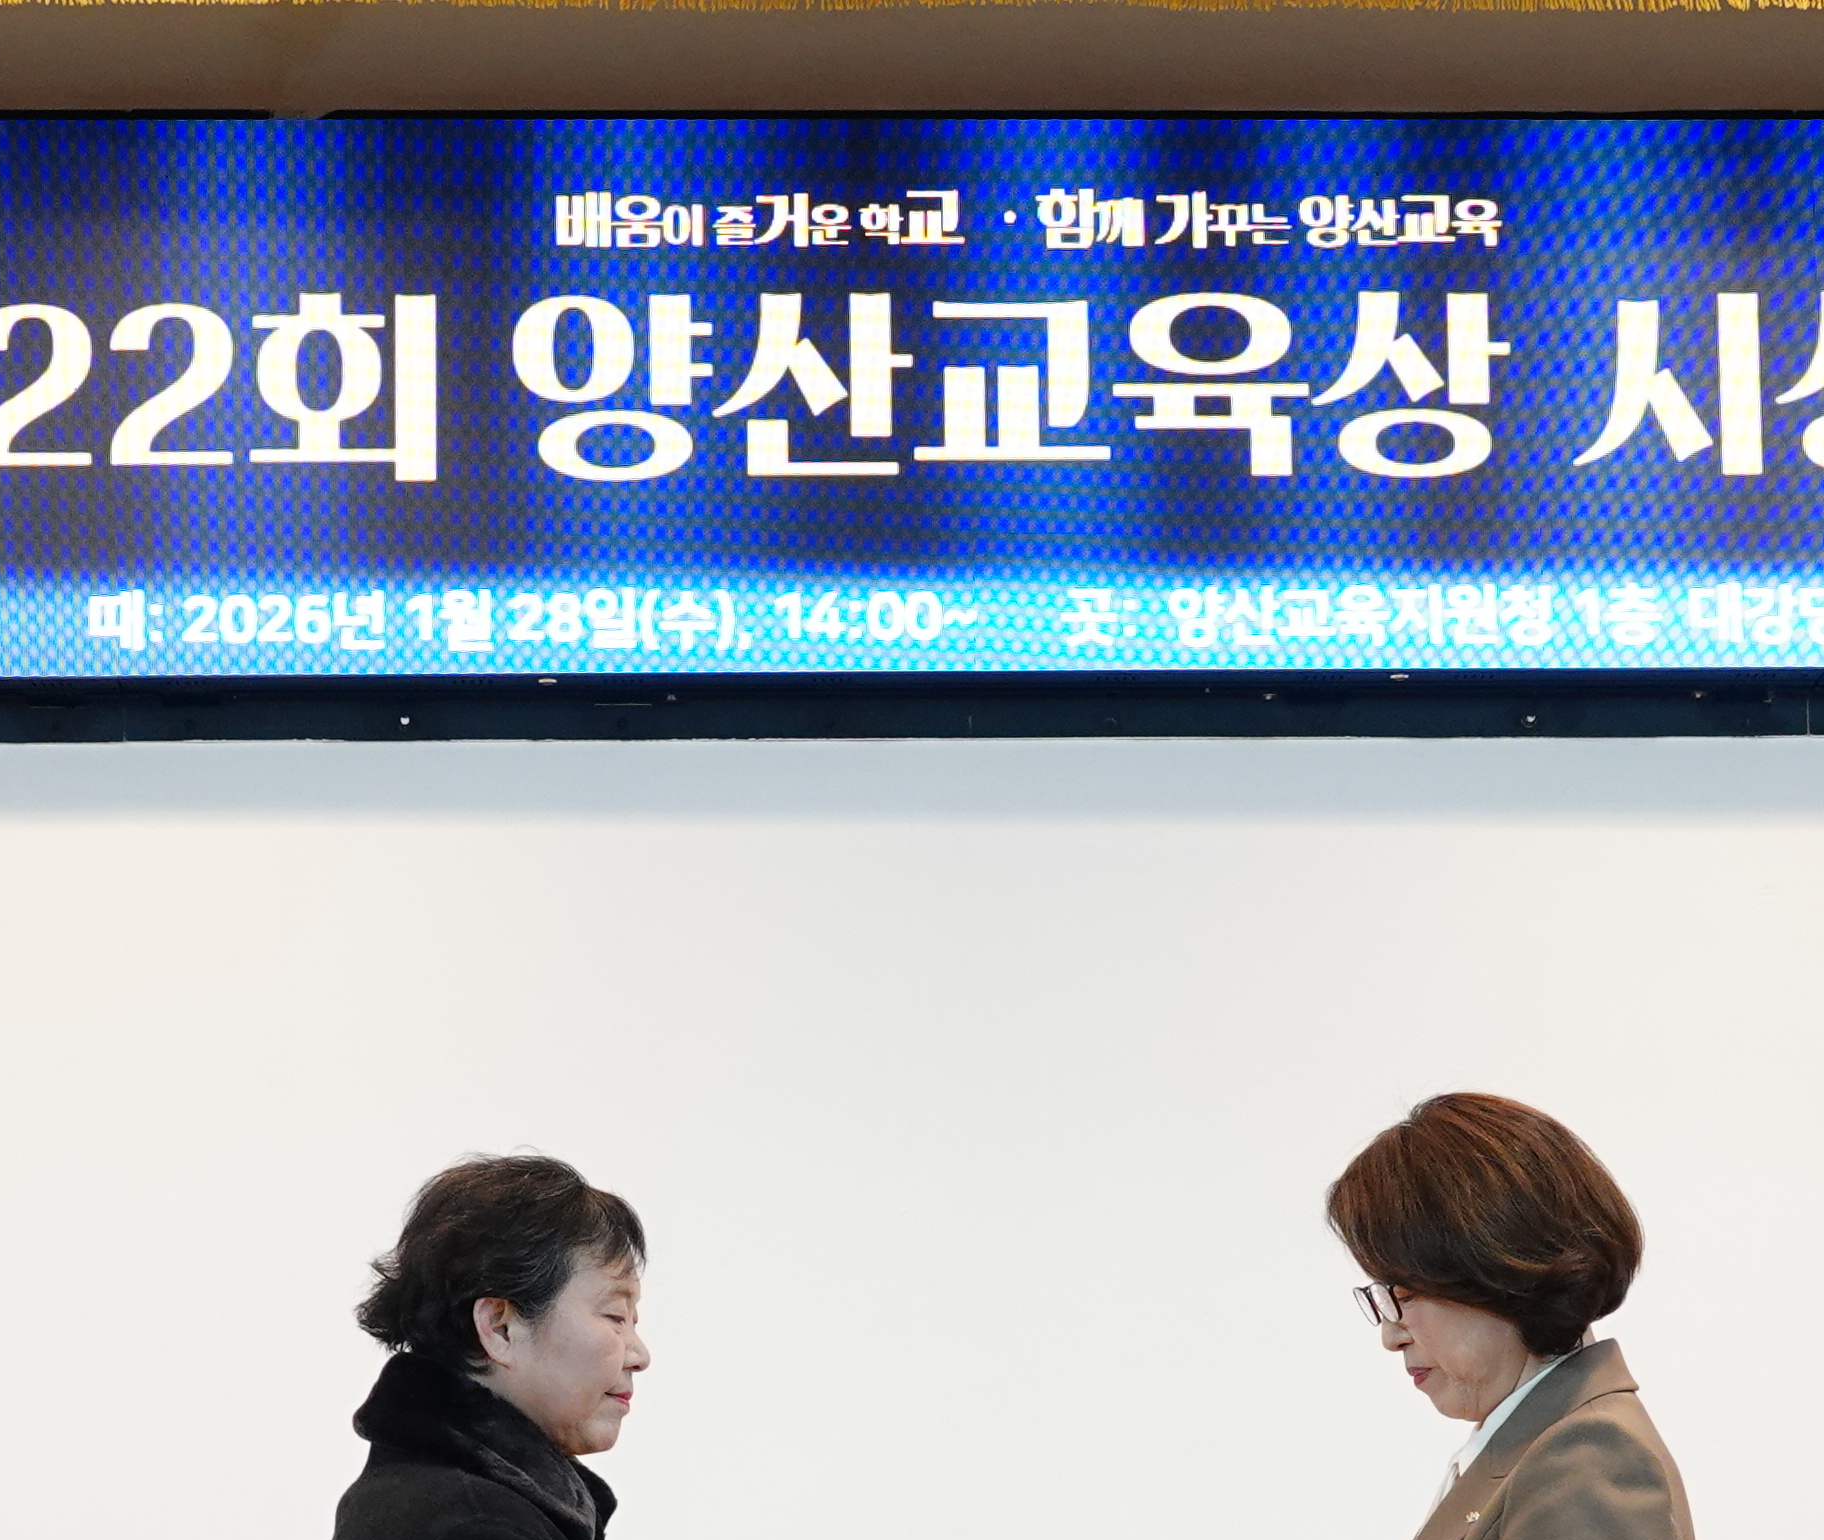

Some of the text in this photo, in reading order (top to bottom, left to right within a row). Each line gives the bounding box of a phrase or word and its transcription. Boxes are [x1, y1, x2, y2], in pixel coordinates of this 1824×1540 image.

[555, 191, 705, 248] 배움이
[712, 193, 853, 247] 즐거운
[858, 189, 966, 245] 학교
[1035, 188, 1145, 249] 함께
[1154, 191, 1292, 249] 가꾸는
[1298, 194, 1503, 249] 양산교육
[511, 291, 1511, 482] 양산교육상
[88, 589, 164, 651] 때:
[181, 589, 385, 651] 2026년
[406, 588, 493, 652] 1월
[508, 587, 753, 650] 28일(수),
[776, 590, 977, 641] 14:00~
[1060, 586, 1137, 647] 곳:
[1168, 583, 1553, 647] 양산교육지원청
[1577, 582, 1662, 646] 1층
